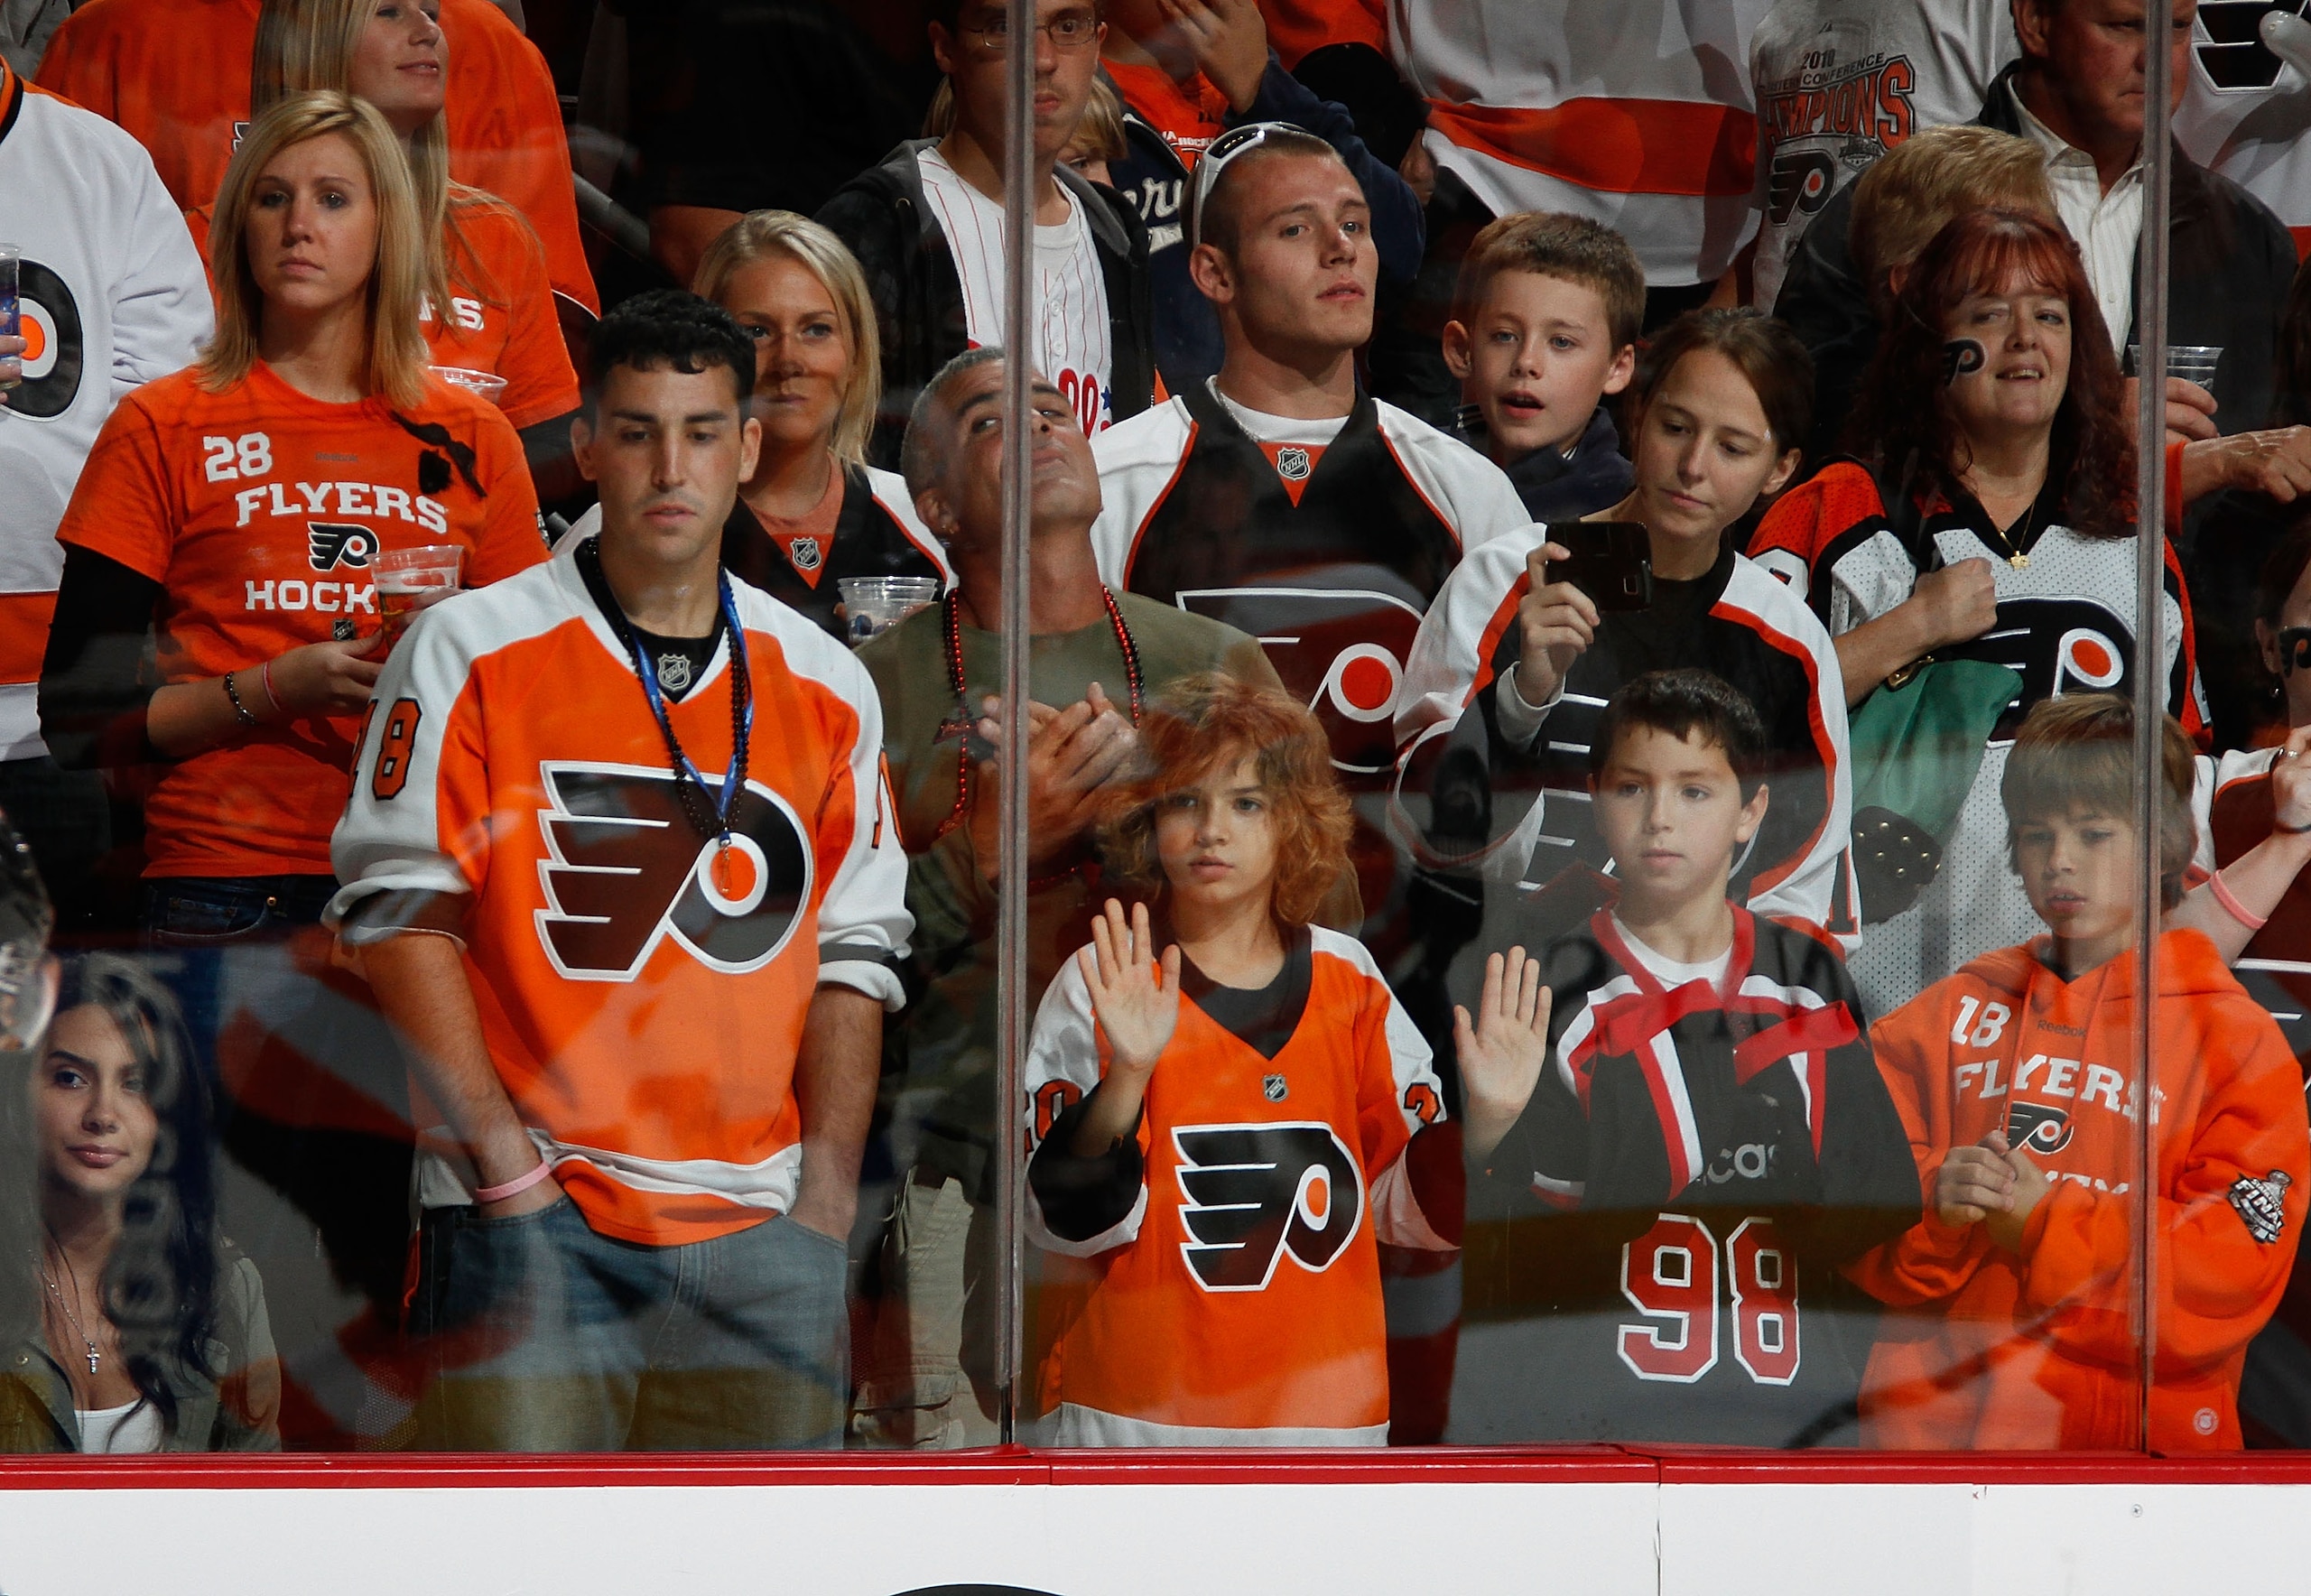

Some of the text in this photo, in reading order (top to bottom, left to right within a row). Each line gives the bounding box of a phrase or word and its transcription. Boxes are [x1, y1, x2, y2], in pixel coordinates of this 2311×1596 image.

[1801, 49, 1835, 70] 2010
[1802, 52, 1885, 85] CONFERENCE
[1763, 54, 1917, 152] AMPIONS
[203, 431, 273, 483] 28
[236, 481, 447, 534] FLYERS
[245, 580, 376, 614] HOCK
[1951, 995, 2012, 1048] 18
[2037, 1019, 2086, 1037] Reebok
[1617, 1211, 1801, 1387] 98
